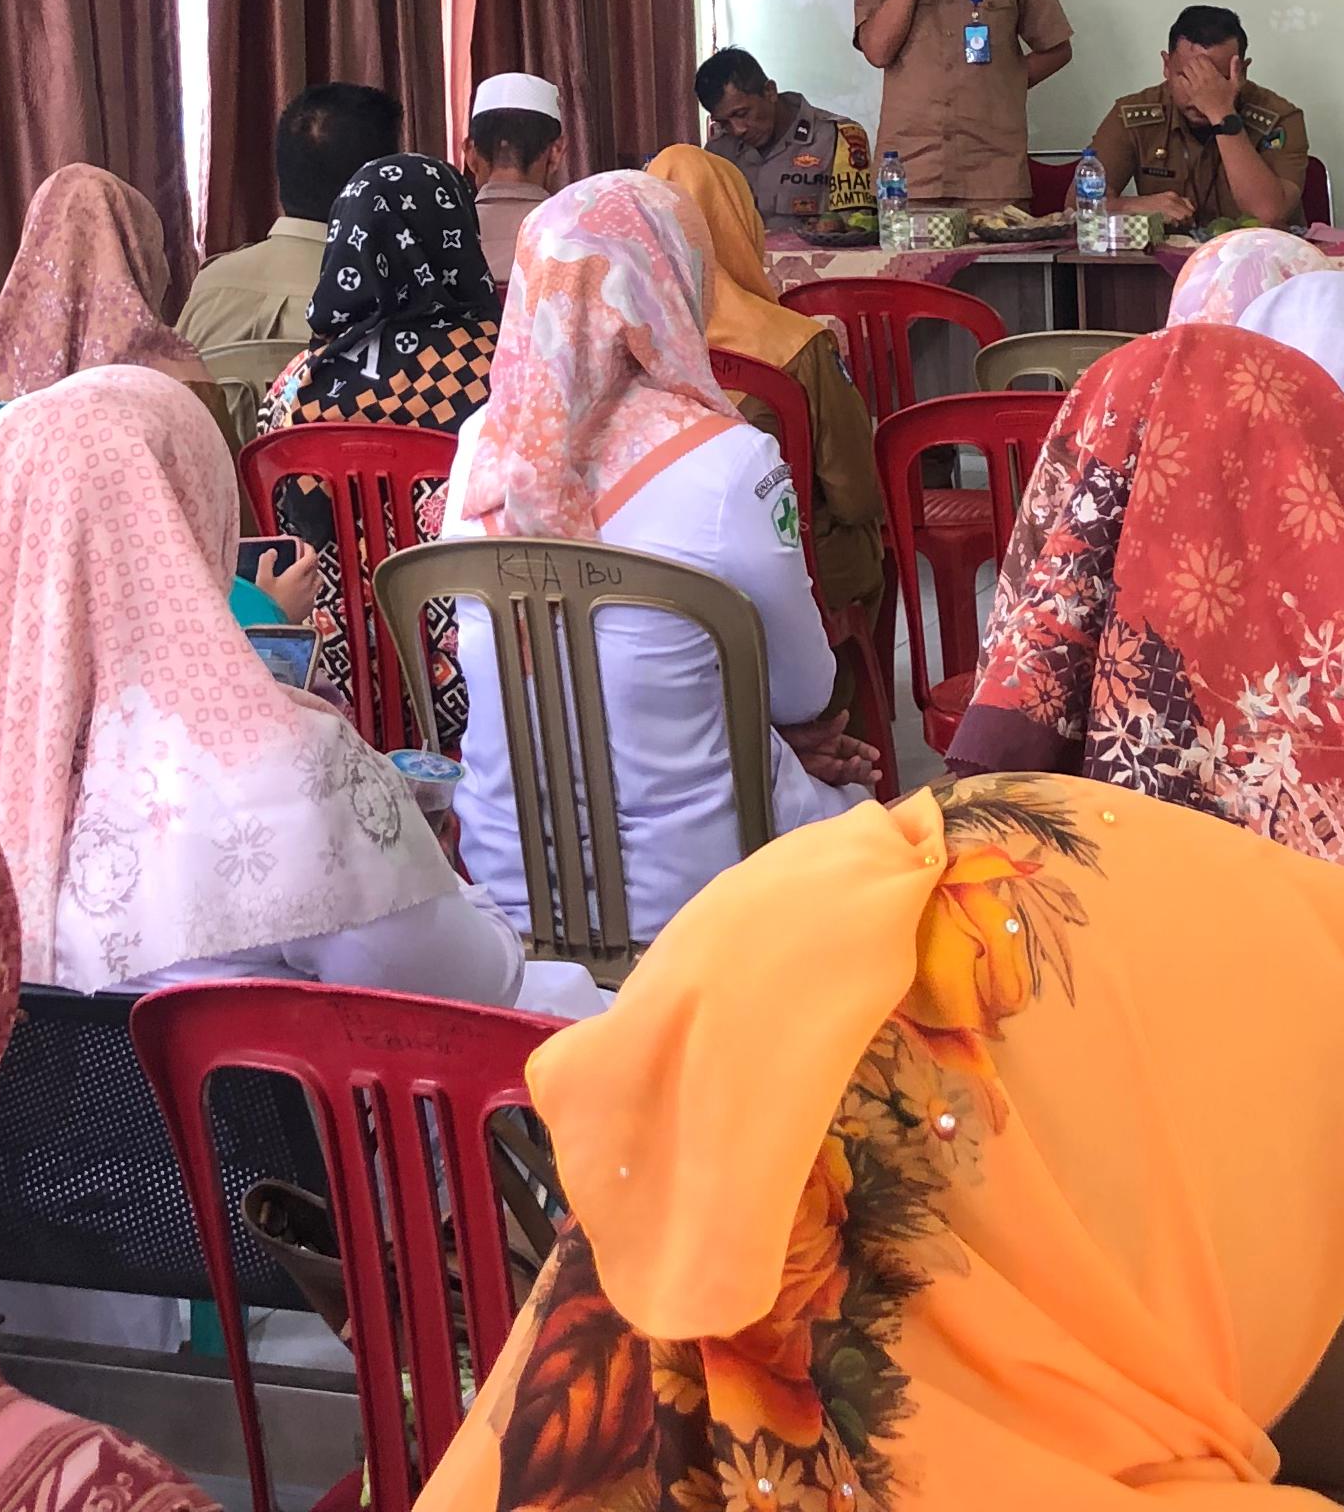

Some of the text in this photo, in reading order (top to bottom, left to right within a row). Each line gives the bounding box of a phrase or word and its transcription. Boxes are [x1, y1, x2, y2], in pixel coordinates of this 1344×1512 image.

[780, 173, 829, 186] POLRI
[496, 548, 623, 591] KIA IBU
